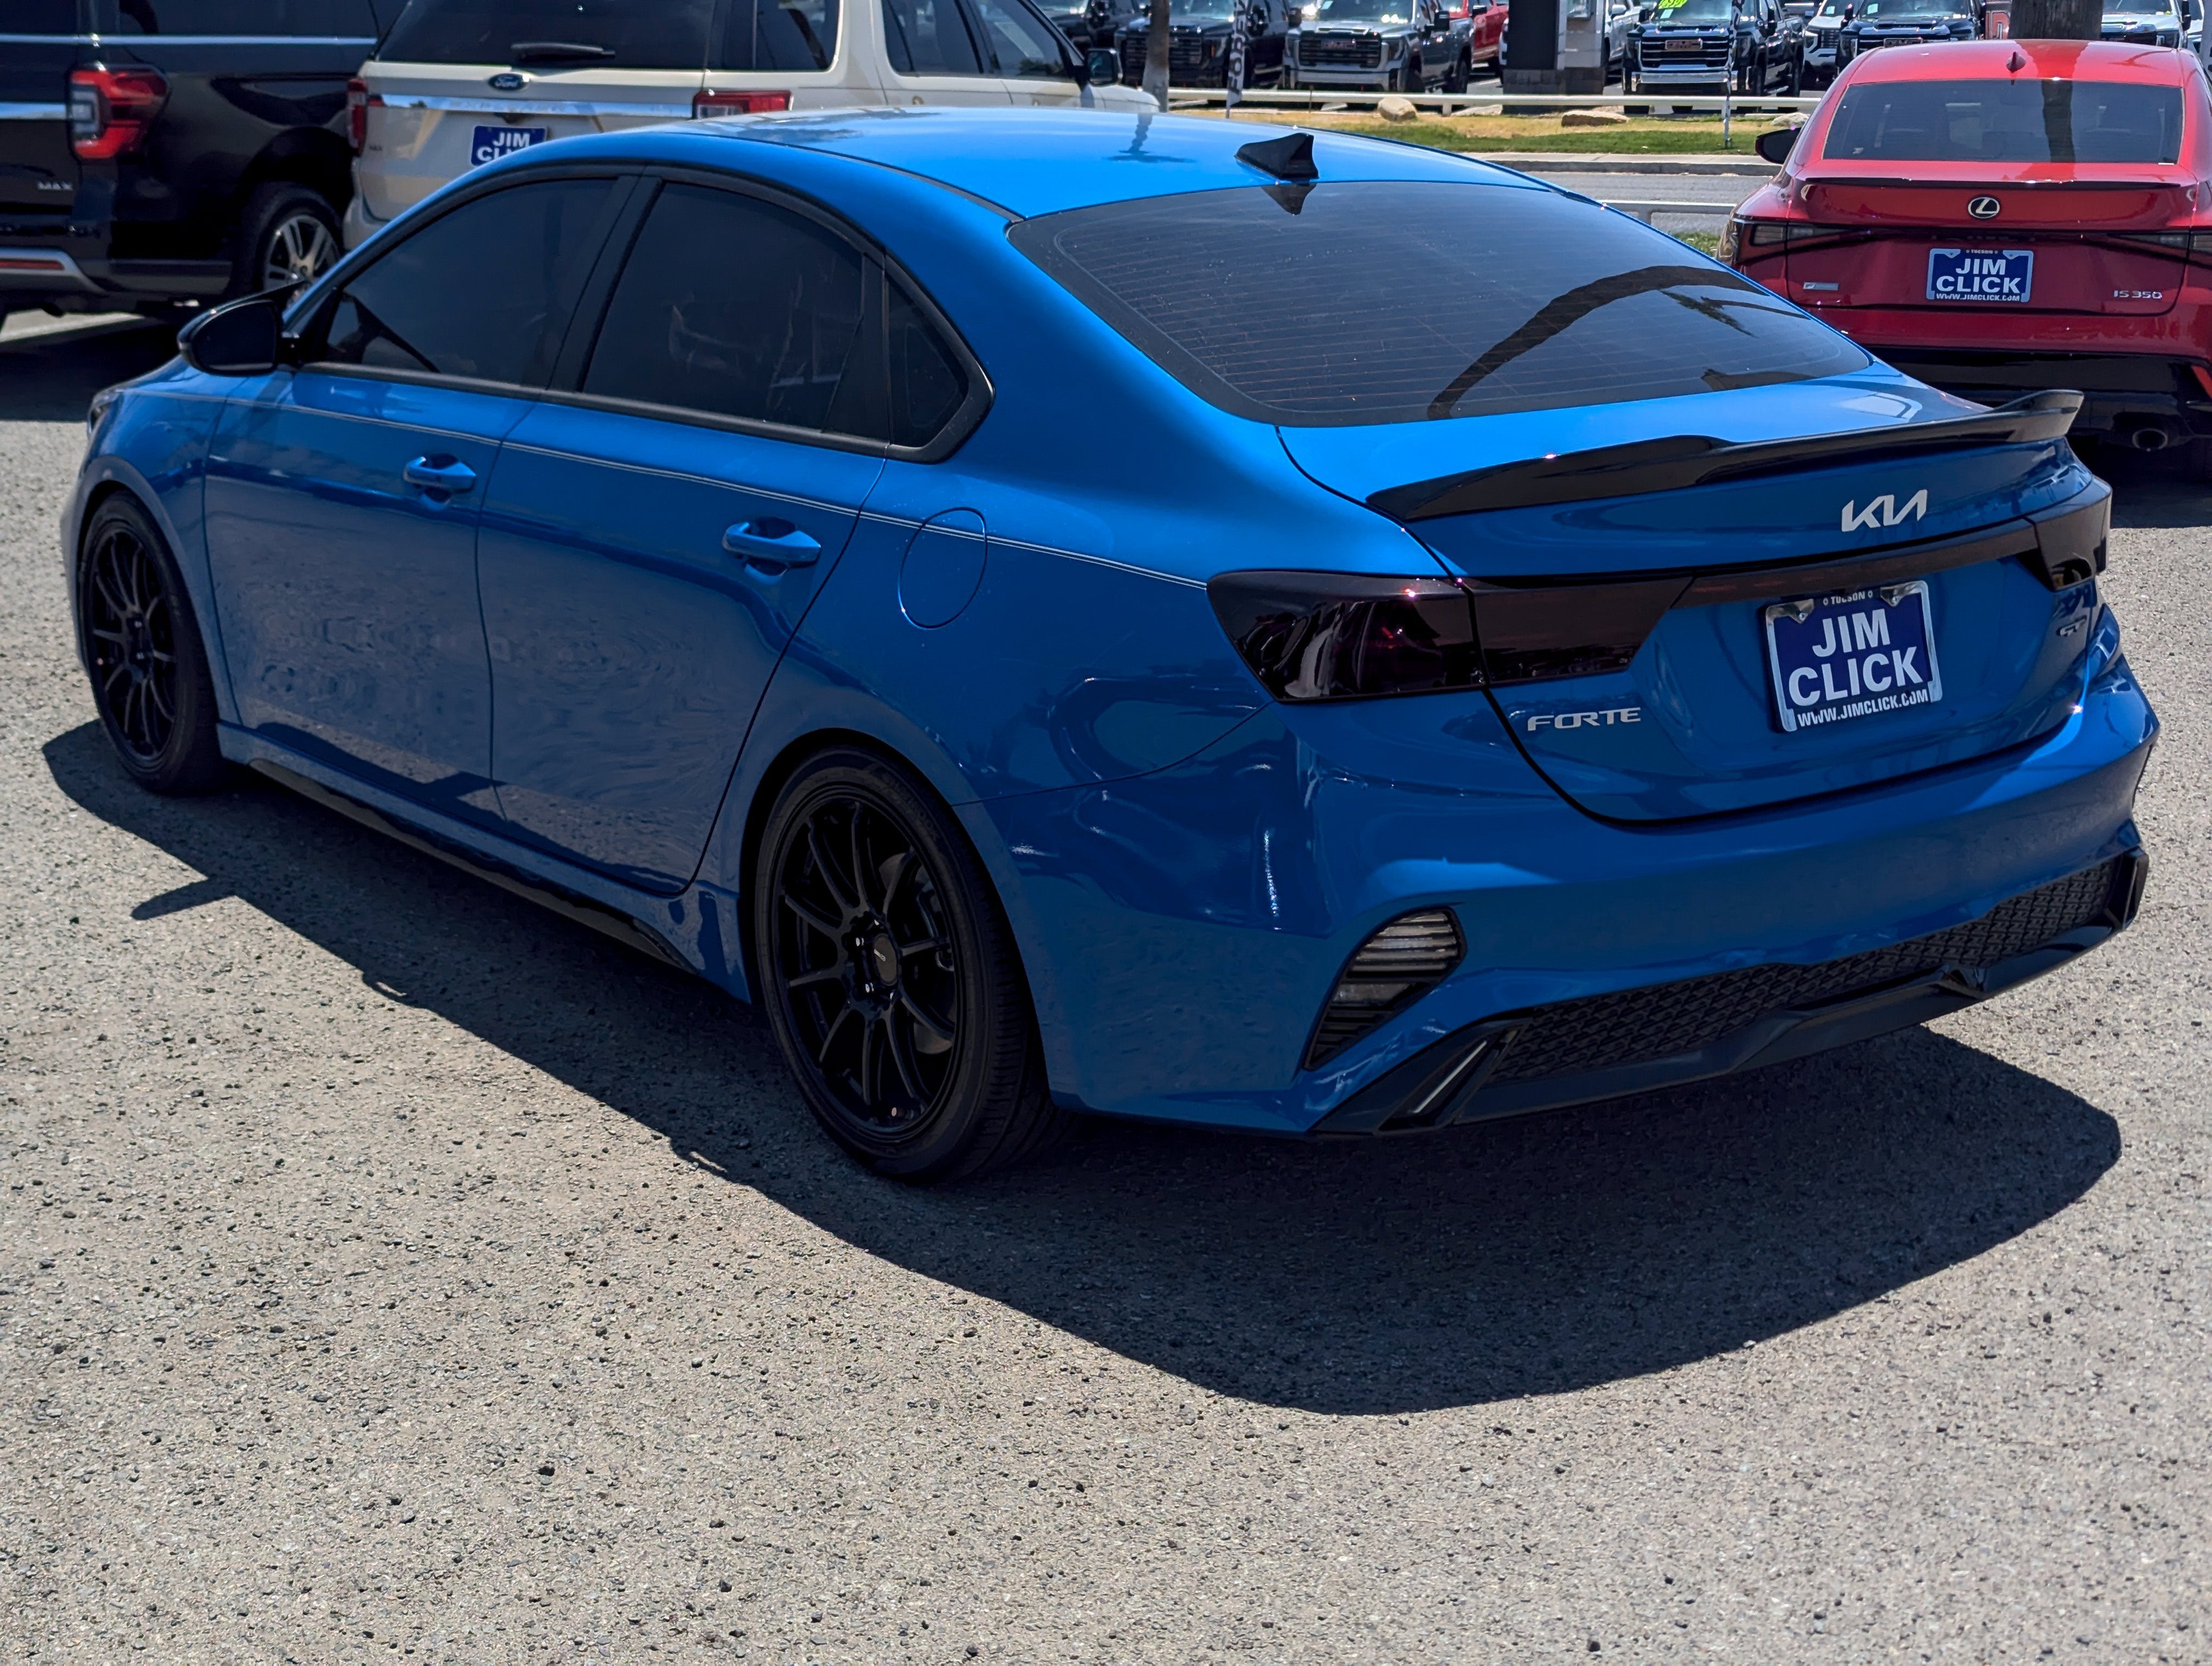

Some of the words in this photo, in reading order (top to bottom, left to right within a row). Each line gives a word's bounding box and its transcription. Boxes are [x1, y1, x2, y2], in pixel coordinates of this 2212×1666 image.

[494, 75, 519, 87] Ford
[492, 132, 530, 147] JIM
[37, 181, 73, 190] MAX
[1955, 258, 2006, 275] JIM
[1936, 275, 2022, 293] CLICK
[1936, 293, 2020, 302] WWW.JIMCLICK.COM
[2131, 291, 2163, 299] 350
[1830, 591, 1866, 605] TUCSON
[1812, 608, 1891, 657] JIM
[1789, 646, 1924, 706] CLICK
[1797, 689, 1929, 727] WWW.JIMCLICK.COM
[1527, 707, 1642, 732] FORTE
